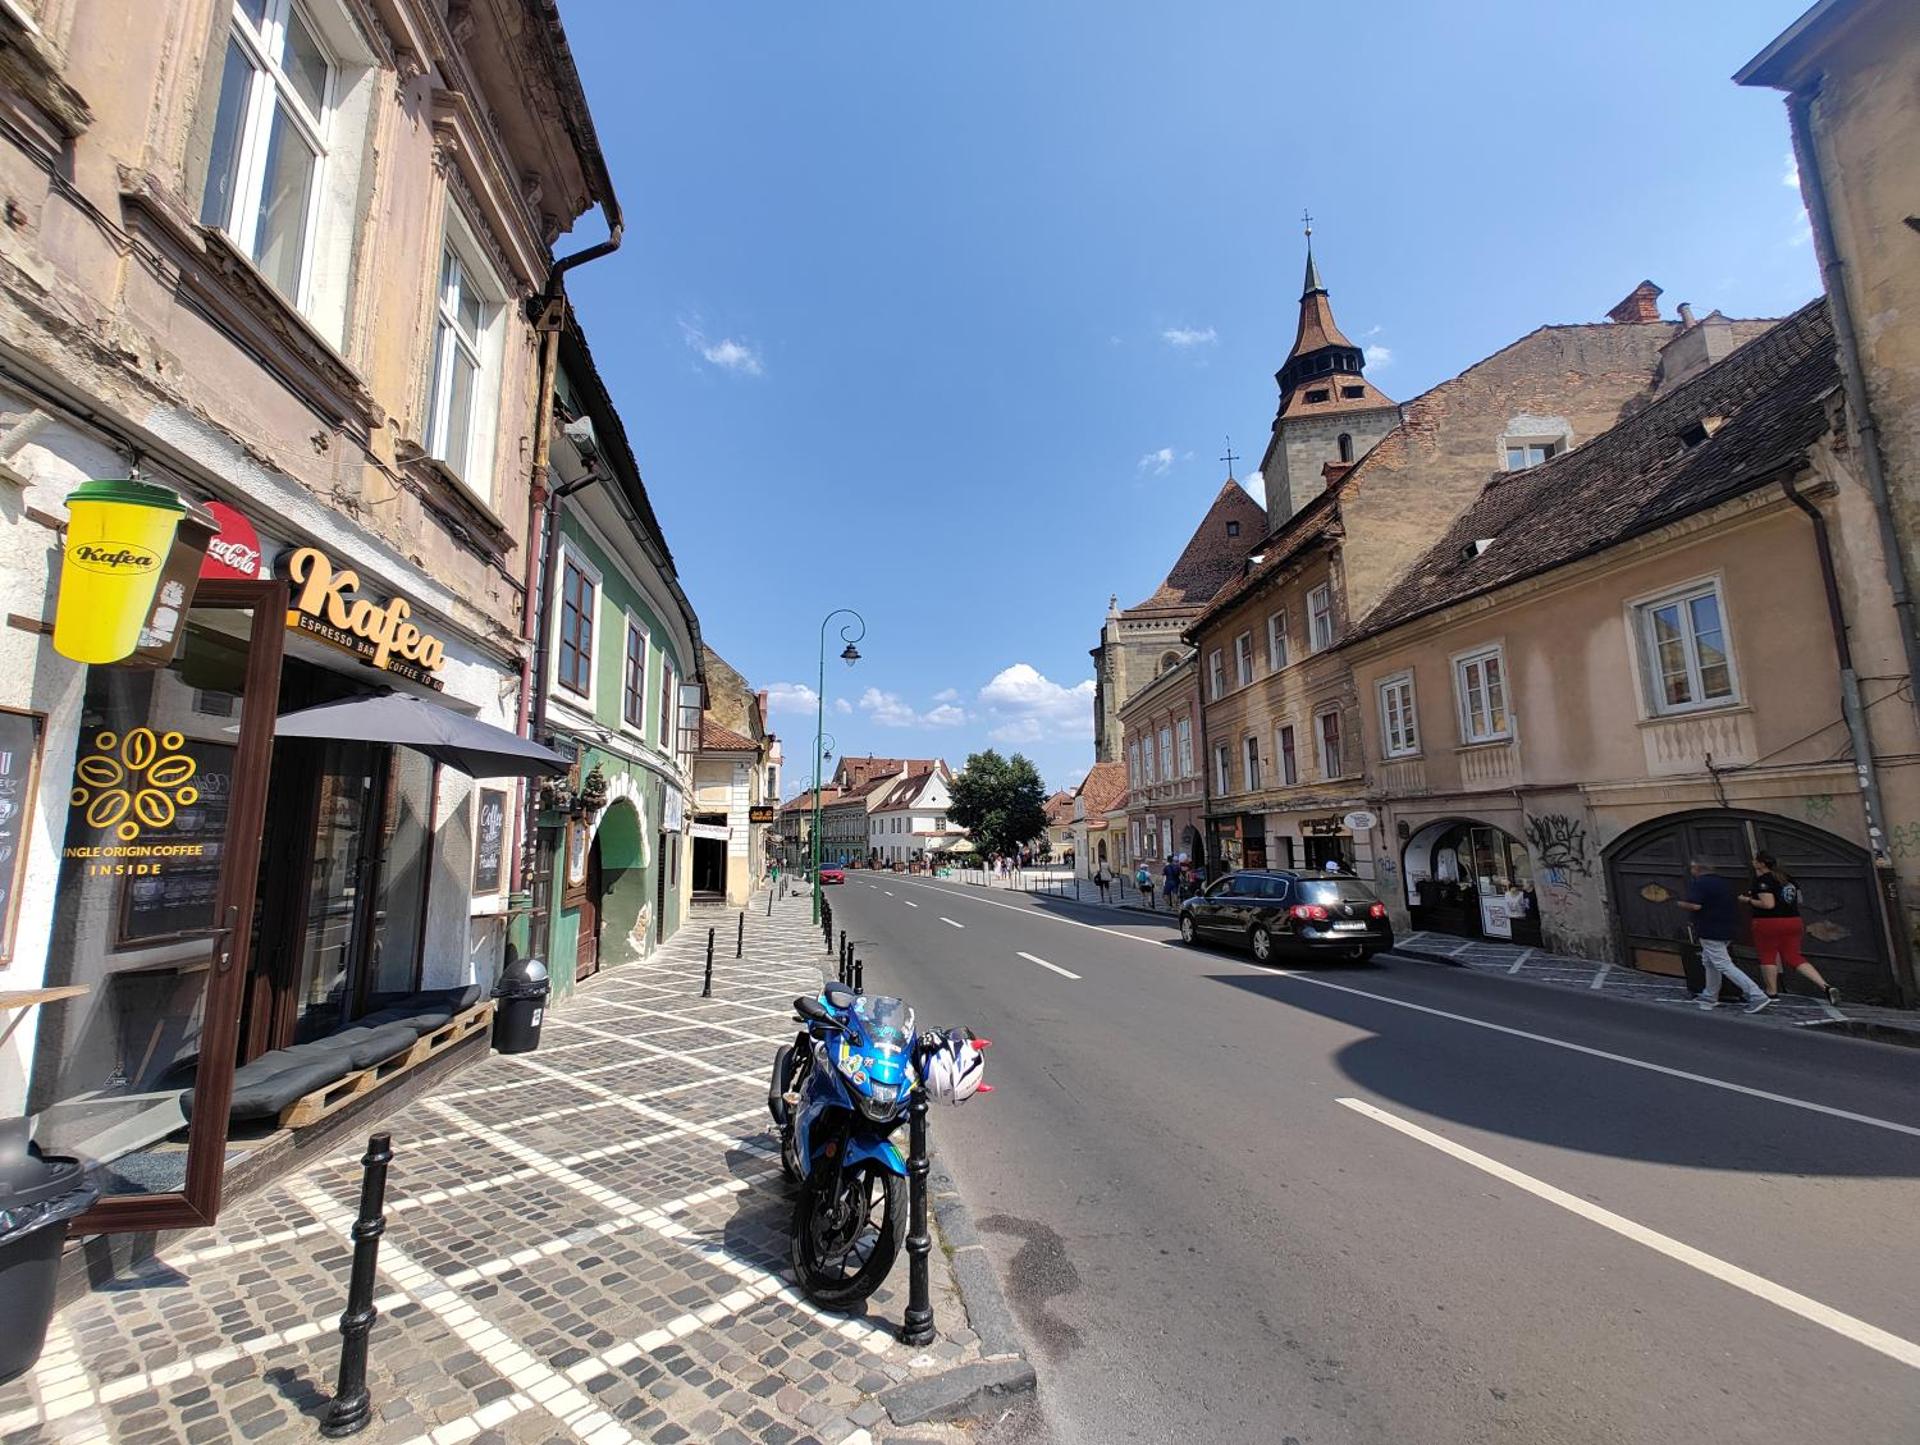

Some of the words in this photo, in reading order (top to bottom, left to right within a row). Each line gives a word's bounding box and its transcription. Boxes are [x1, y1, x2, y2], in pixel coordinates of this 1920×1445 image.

[77, 546, 153, 567] Kafea
[290, 547, 446, 671] Kafea
[300, 617, 353, 647] ESPRESSO
[357, 642, 375, 657] BAR
[388, 660, 419, 680] COFFEE
[422, 674, 431, 685] TO
[433, 680, 444, 691] GO
[103, 846, 150, 857] ORIGIN
[152, 845, 204, 857] COFFEE
[90, 864, 162, 876] INSIDE
